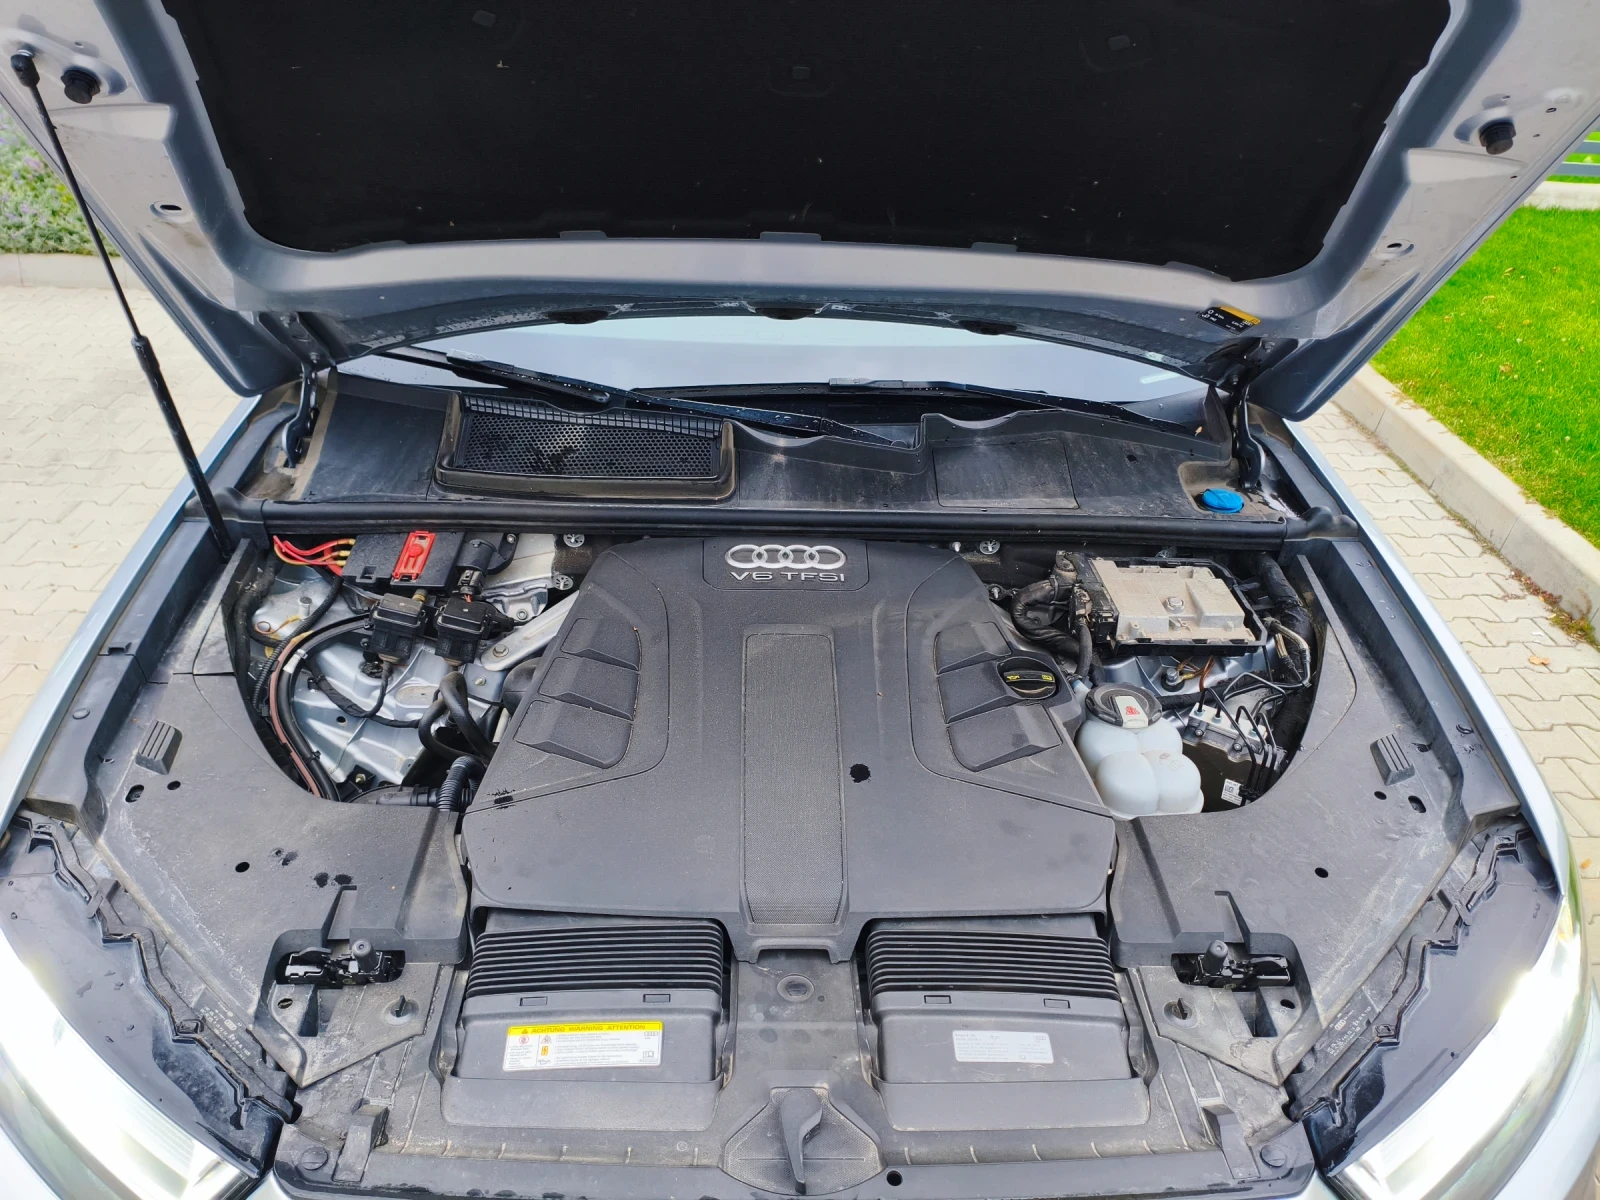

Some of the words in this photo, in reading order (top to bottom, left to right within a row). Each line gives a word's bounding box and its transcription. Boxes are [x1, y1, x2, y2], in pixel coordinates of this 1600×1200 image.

[730, 571, 773, 582] V6
[780, 571, 845, 582] TFSI
[531, 1026, 565, 1034] ACHTUNG
[568, 1025, 603, 1033] WARNING
